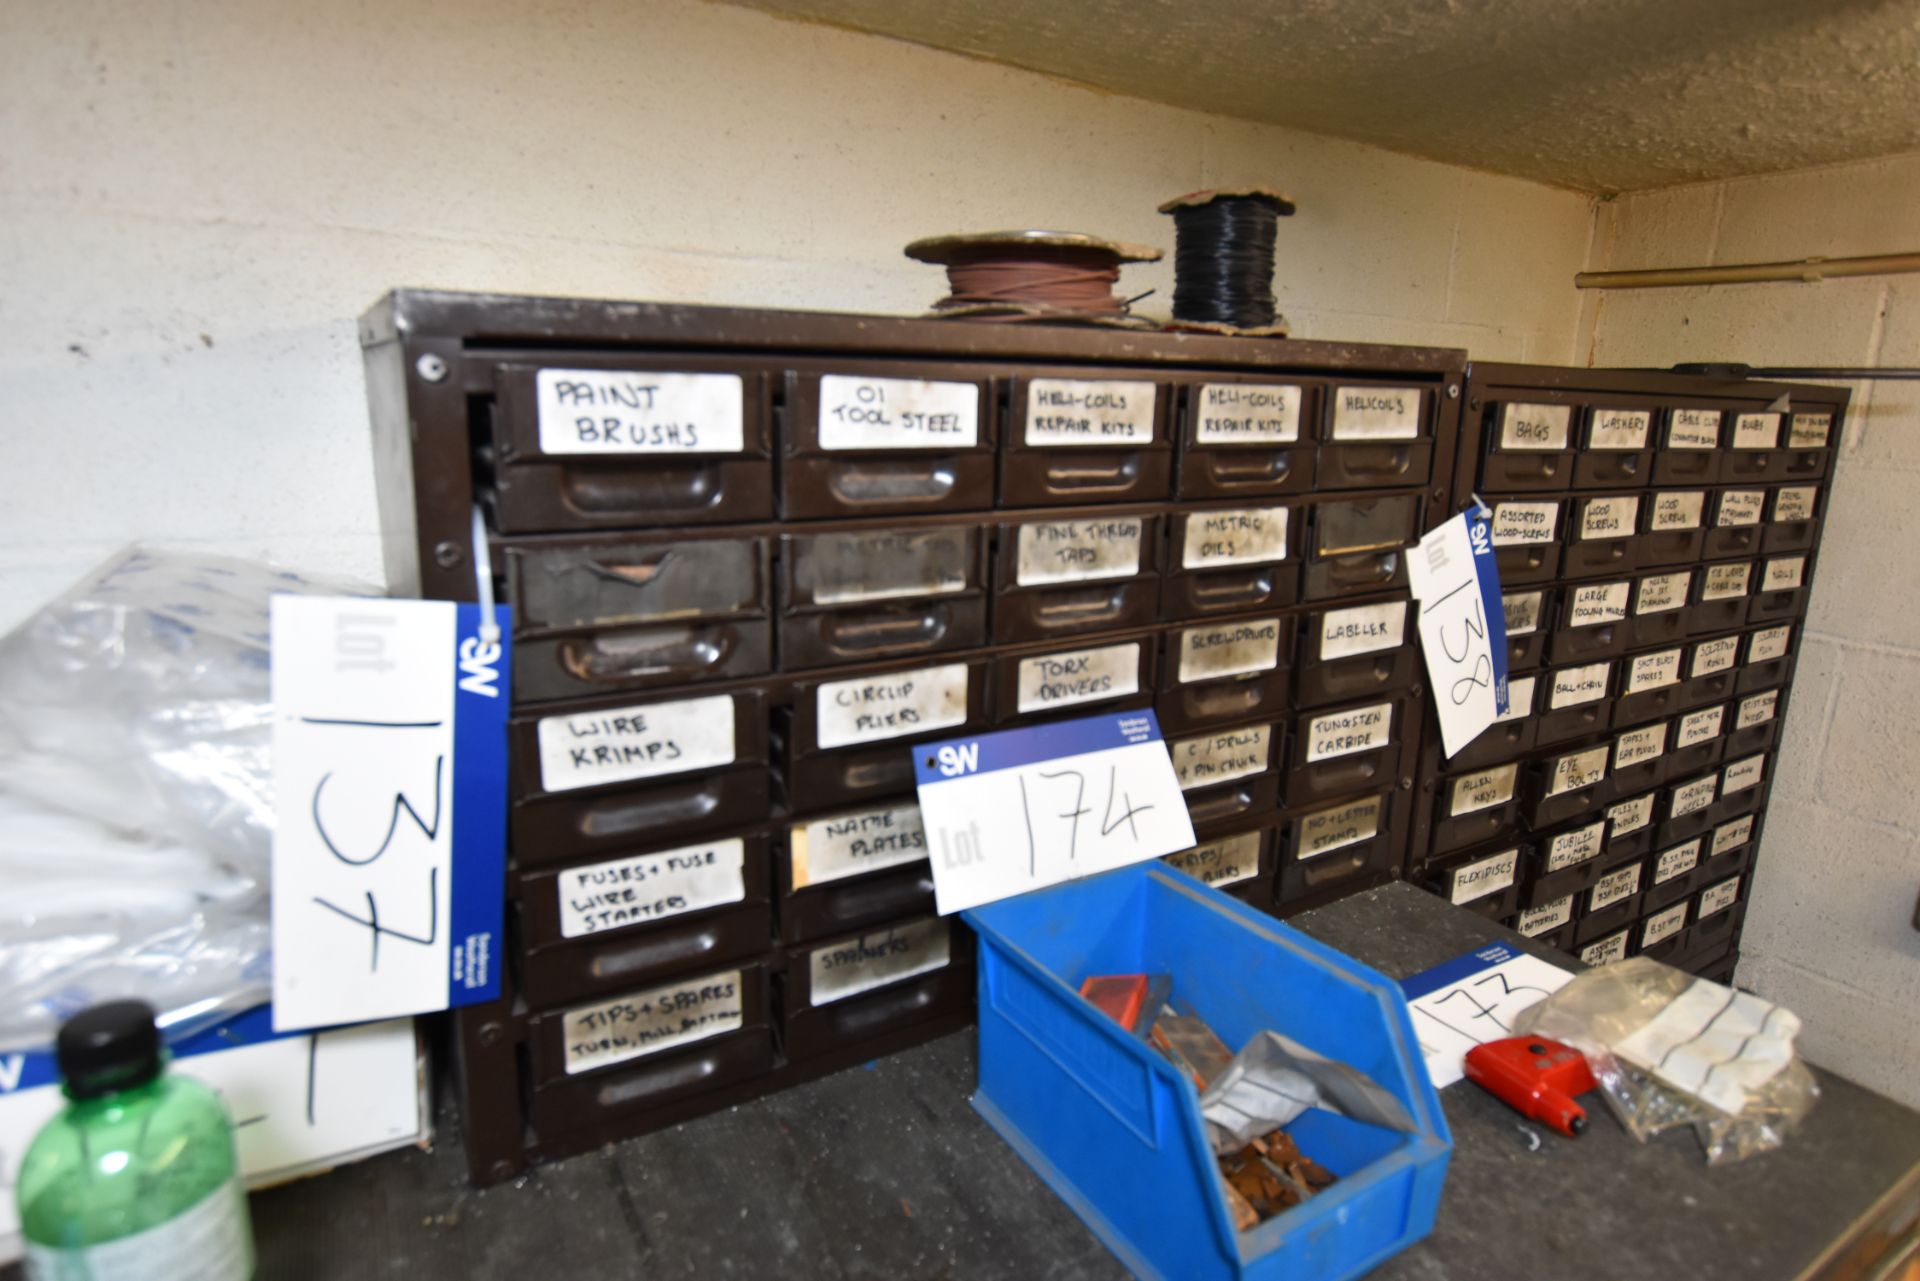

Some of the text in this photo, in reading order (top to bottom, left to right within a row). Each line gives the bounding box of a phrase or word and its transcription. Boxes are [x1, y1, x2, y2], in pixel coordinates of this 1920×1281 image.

[555, 381, 659, 408] PAINT
[1037, 390, 1127, 410] HELI-COILS
[1208, 389, 1285, 411] HELI-COILS
[832, 406, 963, 433] TOOL STEEL
[1035, 416, 1135, 435] REPAIR KITS
[1205, 416, 1283, 433] REPAIR KITS
[1516, 421, 1549, 441] BAGS
[1601, 416, 1645, 431] WASHERS
[576, 418, 698, 446] BRUSHS
[1500, 509, 1545, 524] ASSORTED
[1588, 504, 1611, 516] WOOD
[1036, 522, 1141, 540] FINE THREAD
[1206, 518, 1261, 535] METRIC
[1586, 518, 1619, 531] SCREWS
[1201, 540, 1236, 557] DIES
[1471, 523, 1490, 555] SW
[1054, 546, 1096, 563] TAPS
[1426, 534, 1450, 574] Lot
[1578, 590, 1608, 602] LARGE
[1326, 621, 1388, 640] LABELER
[1424, 579, 1490, 705] 138
[336, 613, 397, 673] Lot
[459, 638, 500, 698] SW
[1034, 657, 1089, 676] TORX
[835, 683, 915, 706] CIRCLIP
[1038, 677, 1112, 700] DRIVERS
[1555, 682, 1575, 694] BALL
[1581, 680, 1603, 691] CHAIN
[569, 715, 648, 738] WIRE
[855, 709, 920, 732] PLIERS
[1315, 712, 1382, 733] TUNGSTEN
[571, 741, 681, 769] KRIMPS
[1317, 733, 1372, 754] CARBIDE
[937, 743, 979, 776] SW
[1194, 762, 1216, 777] PIN
[1560, 759, 1577, 773] EYE
[1462, 776, 1492, 791] ALLEN
[1473, 789, 1497, 804] KEYS
[826, 812, 894, 839] NAME
[1019, 764, 1155, 877] 174
[302, 714, 443, 974] 137
[850, 831, 924, 858] PLATES
[938, 820, 985, 870] Lot
[1556, 829, 1594, 852] JUBILEE
[578, 866, 645, 888] FUSES
[667, 851, 717, 872] FUSE
[1457, 861, 1512, 888] FLEXIDISCS
[571, 889, 637, 912] WIRE
[578, 1004, 637, 1030] TIPS
[659, 983, 735, 1014] SPARES
